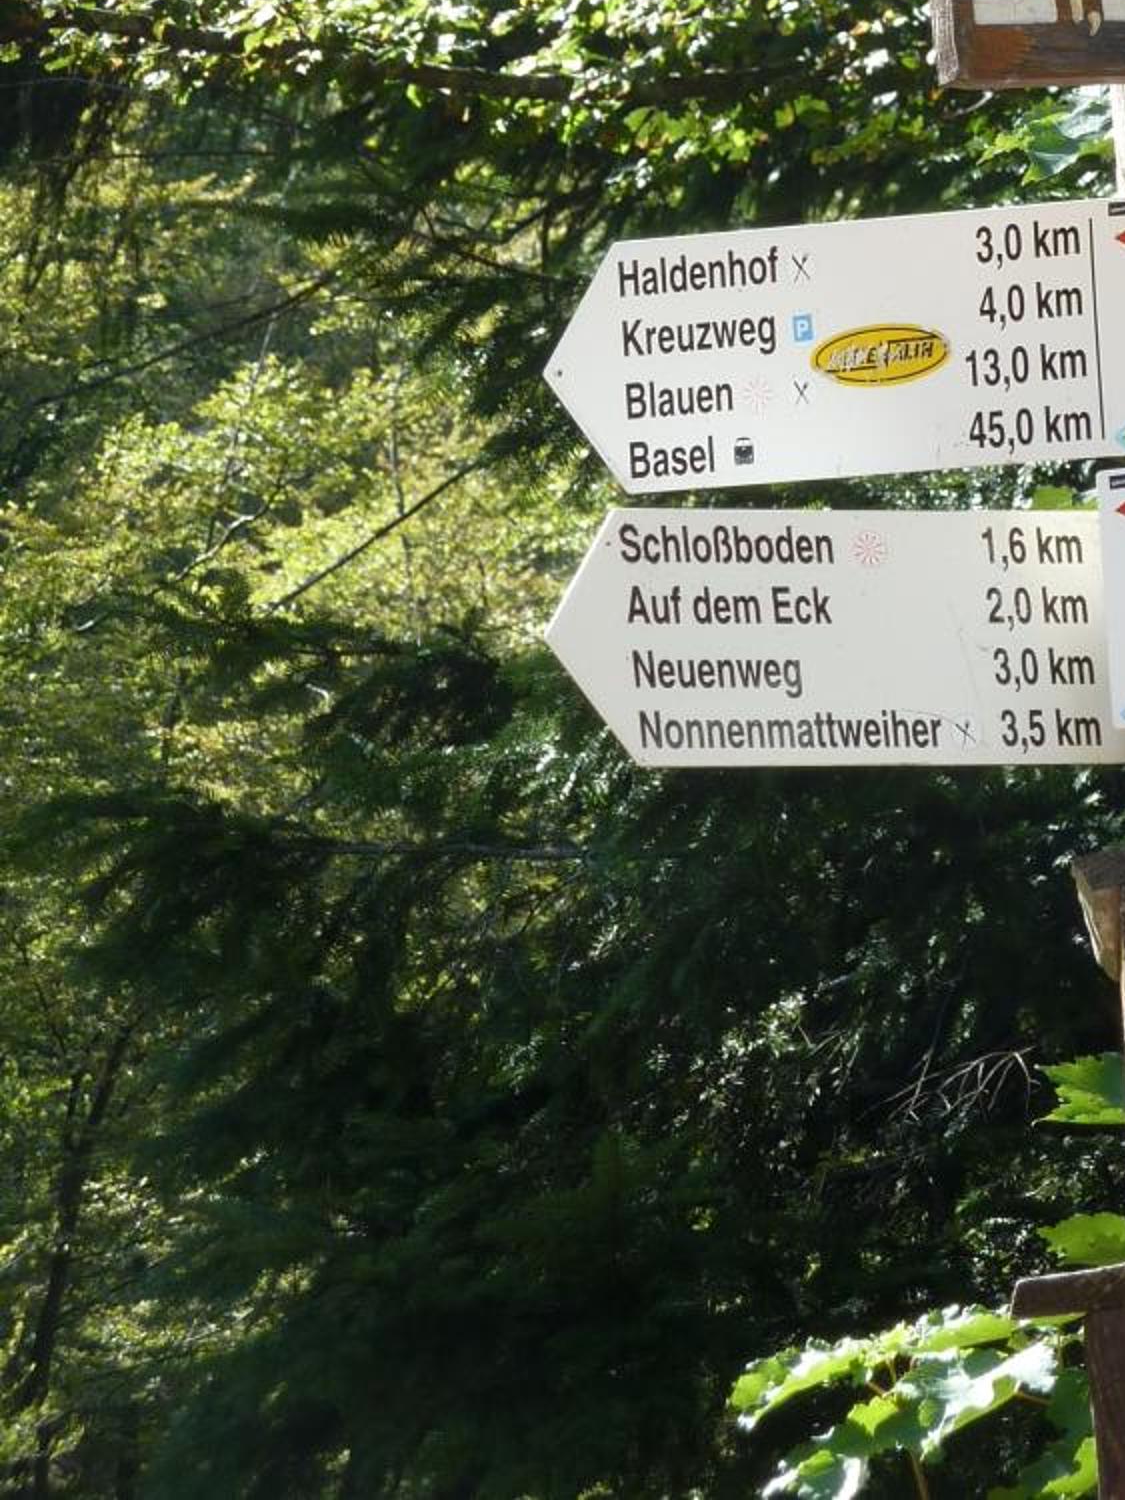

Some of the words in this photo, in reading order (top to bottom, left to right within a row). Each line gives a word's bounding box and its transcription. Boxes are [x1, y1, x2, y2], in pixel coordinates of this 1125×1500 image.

[618, 246, 778, 297] Haldenhof
[975, 224, 1022, 270] 3,0
[1033, 220, 1080, 257] km
[622, 314, 777, 356] Kreuzweg
[979, 286, 1026, 331] 4,0
[1036, 280, 1083, 318] km
[625, 379, 734, 419] Blauen
[965, 348, 1030, 392] 13,0
[1040, 344, 1088, 381] km
[628, 437, 716, 479] Basel
[969, 410, 1035, 455] 45,0
[1045, 407, 1092, 442] km
[619, 523, 834, 565] Schloßboden
[981, 527, 1028, 572] 1,6
[1036, 527, 1084, 565] km
[627, 586, 681, 624] Auf
[693, 587, 761, 624] dem
[771, 586, 832, 624] Eck
[987, 587, 1033, 631] 2,0
[1042, 587, 1089, 624] km
[632, 650, 801, 698] Neuenweg
[993, 648, 1039, 692] 3,0
[1048, 648, 1095, 685] km
[639, 710, 941, 749] Nonnenmattweiher
[1001, 710, 1047, 753] 3,5
[1057, 709, 1102, 747] km
